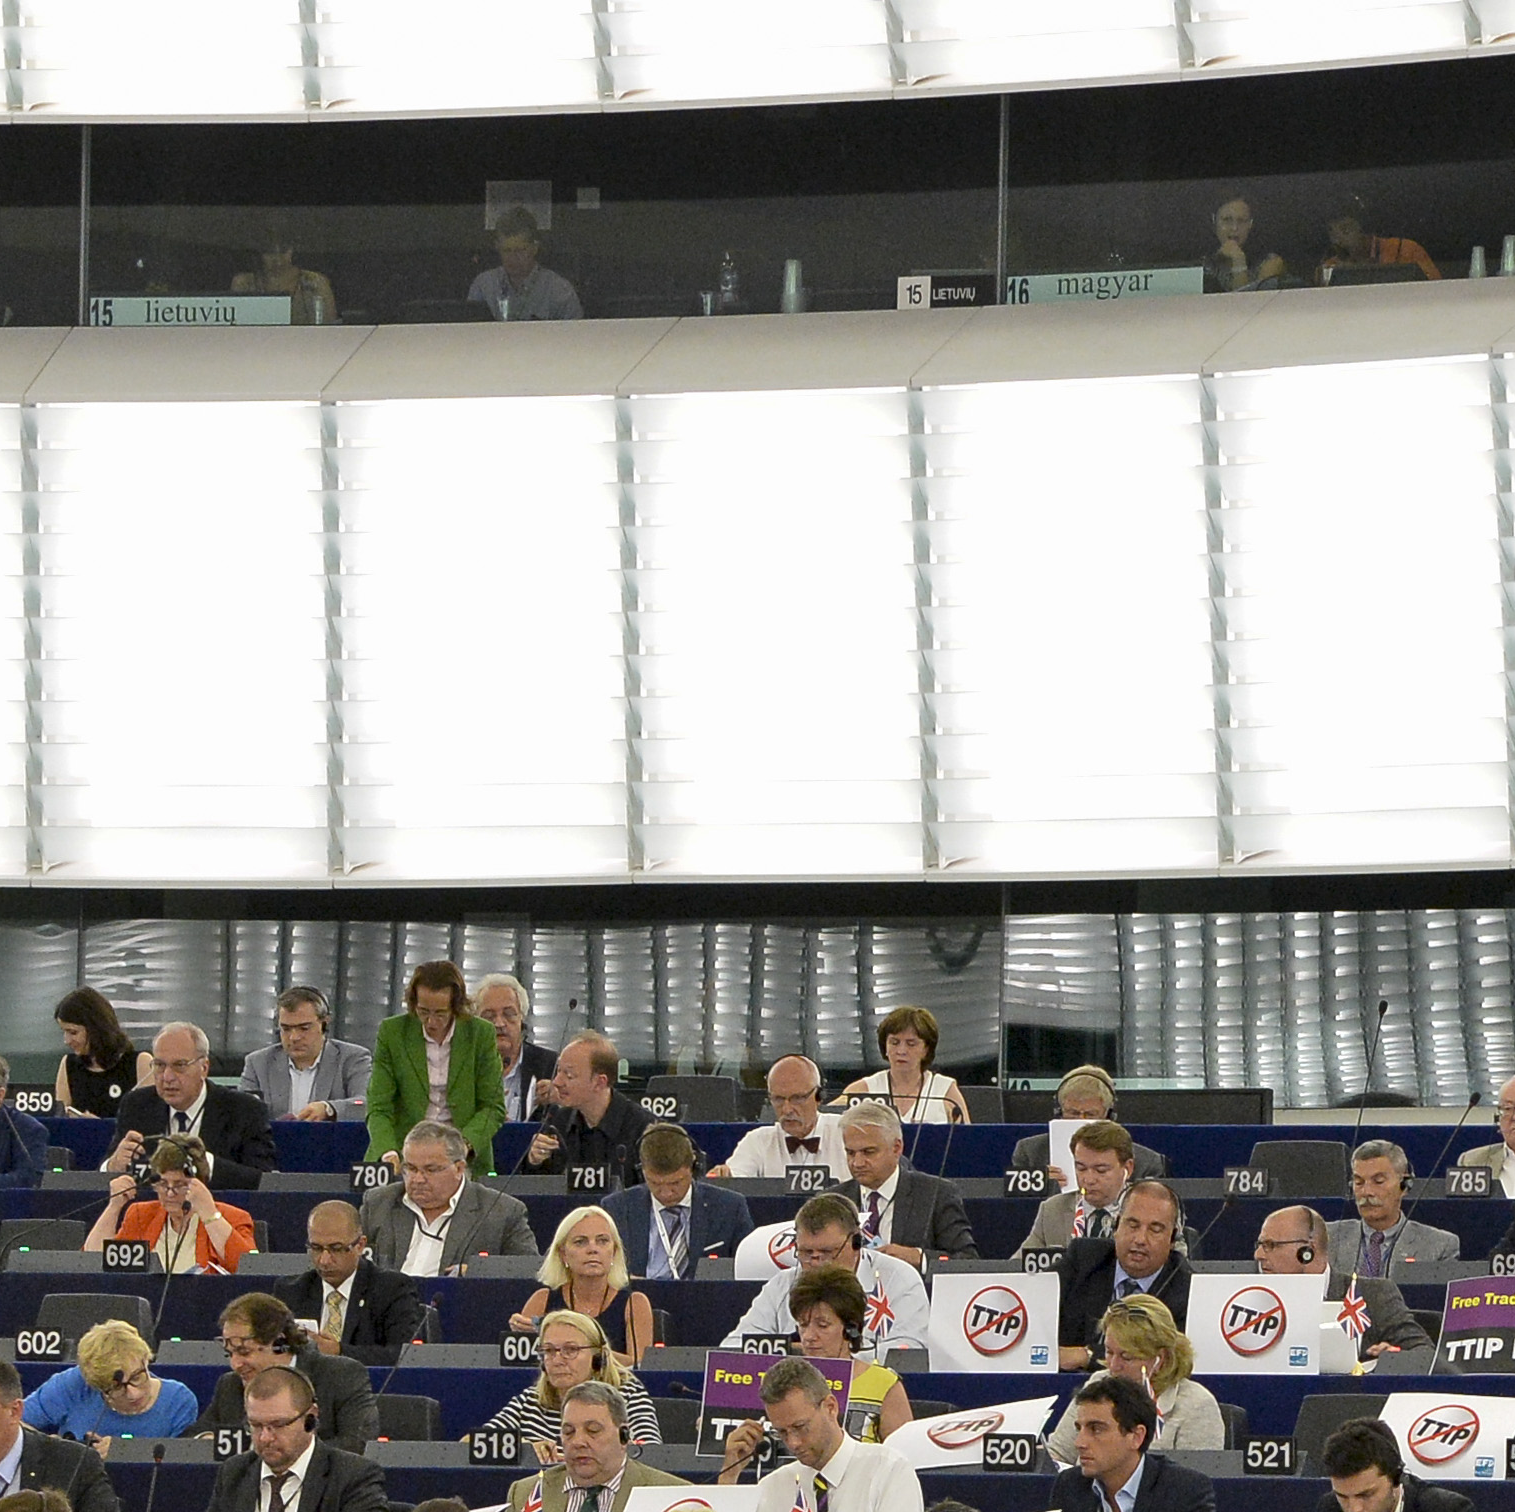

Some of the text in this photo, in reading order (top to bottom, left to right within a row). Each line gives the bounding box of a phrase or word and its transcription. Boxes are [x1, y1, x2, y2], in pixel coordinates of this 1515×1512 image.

[905, 283, 922, 305] 15
[1007, 271, 1154, 305] 16 magyar
[90, 299, 237, 327] 15 lietuvių
[15, 1092, 53, 1113] 859
[641, 1097, 677, 1117] 862
[353, 1166, 389, 1187] 780
[572, 1167, 605, 1188] 781
[789, 1170, 824, 1191] 782
[1008, 1171, 1045, 1192] 783
[1226, 1172, 1264, 1193] 784
[1450, 1171, 1487, 1192] 785
[106, 1245, 144, 1266] 692
[1452, 1295, 1481, 1310] Free
[971, 1304, 1021, 1335] TTIP
[1229, 1304, 1278, 1336] TTIP
[17, 1331, 60, 1355] 602
[744, 1339, 786, 1357] 605
[1445, 1340, 1505, 1362] TTIP
[714, 1369, 753, 1386] Free
[218, 1430, 251, 1454] 51
[1416, 1418, 1471, 1446] TTIP
[473, 1432, 516, 1460] 518
[985, 1439, 1031, 1466] 520
[1246, 1441, 1292, 1468] 521
